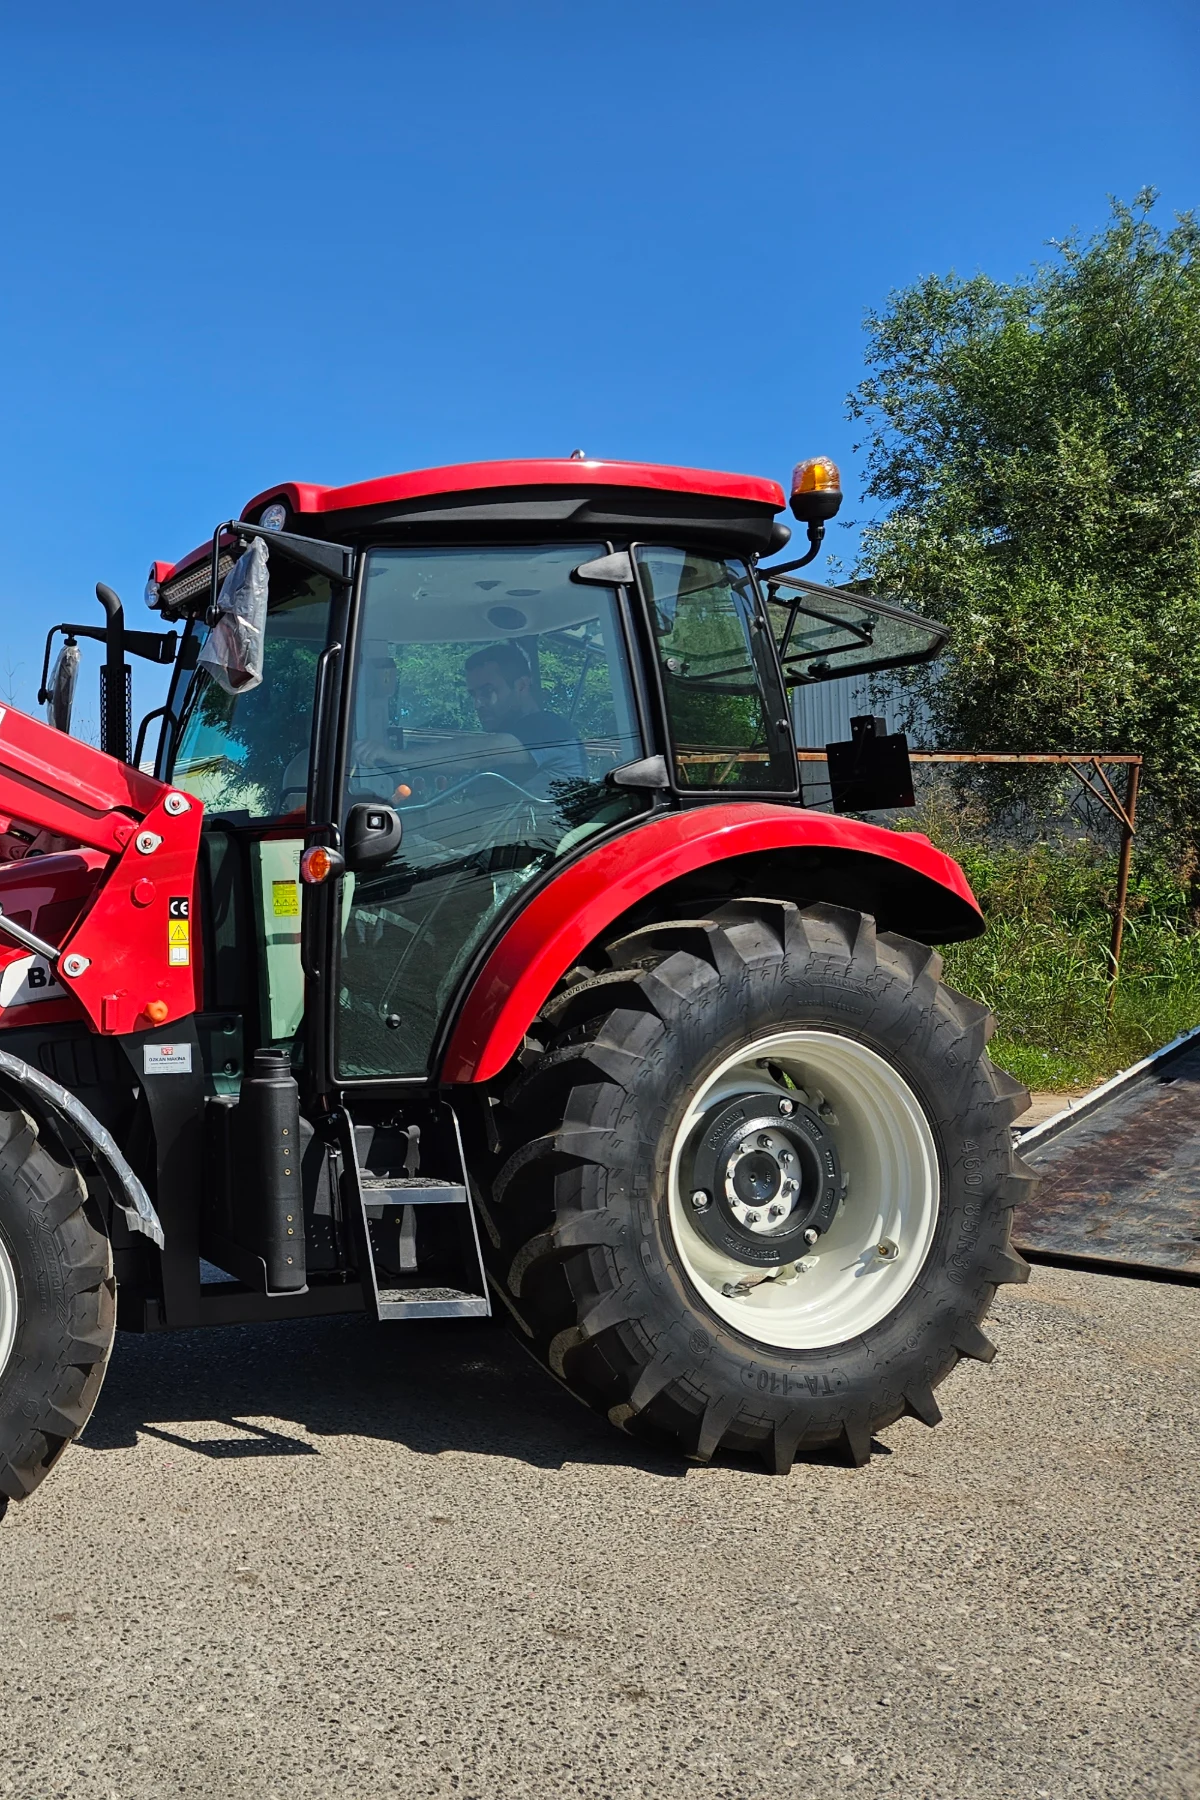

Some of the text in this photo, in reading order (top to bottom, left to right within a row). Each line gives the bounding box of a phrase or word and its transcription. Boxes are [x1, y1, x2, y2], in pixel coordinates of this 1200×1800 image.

[169, 900, 189, 916] CE
[946, 1139, 985, 1286] 460/85R30
[755, 1369, 837, 1398] TA-110
